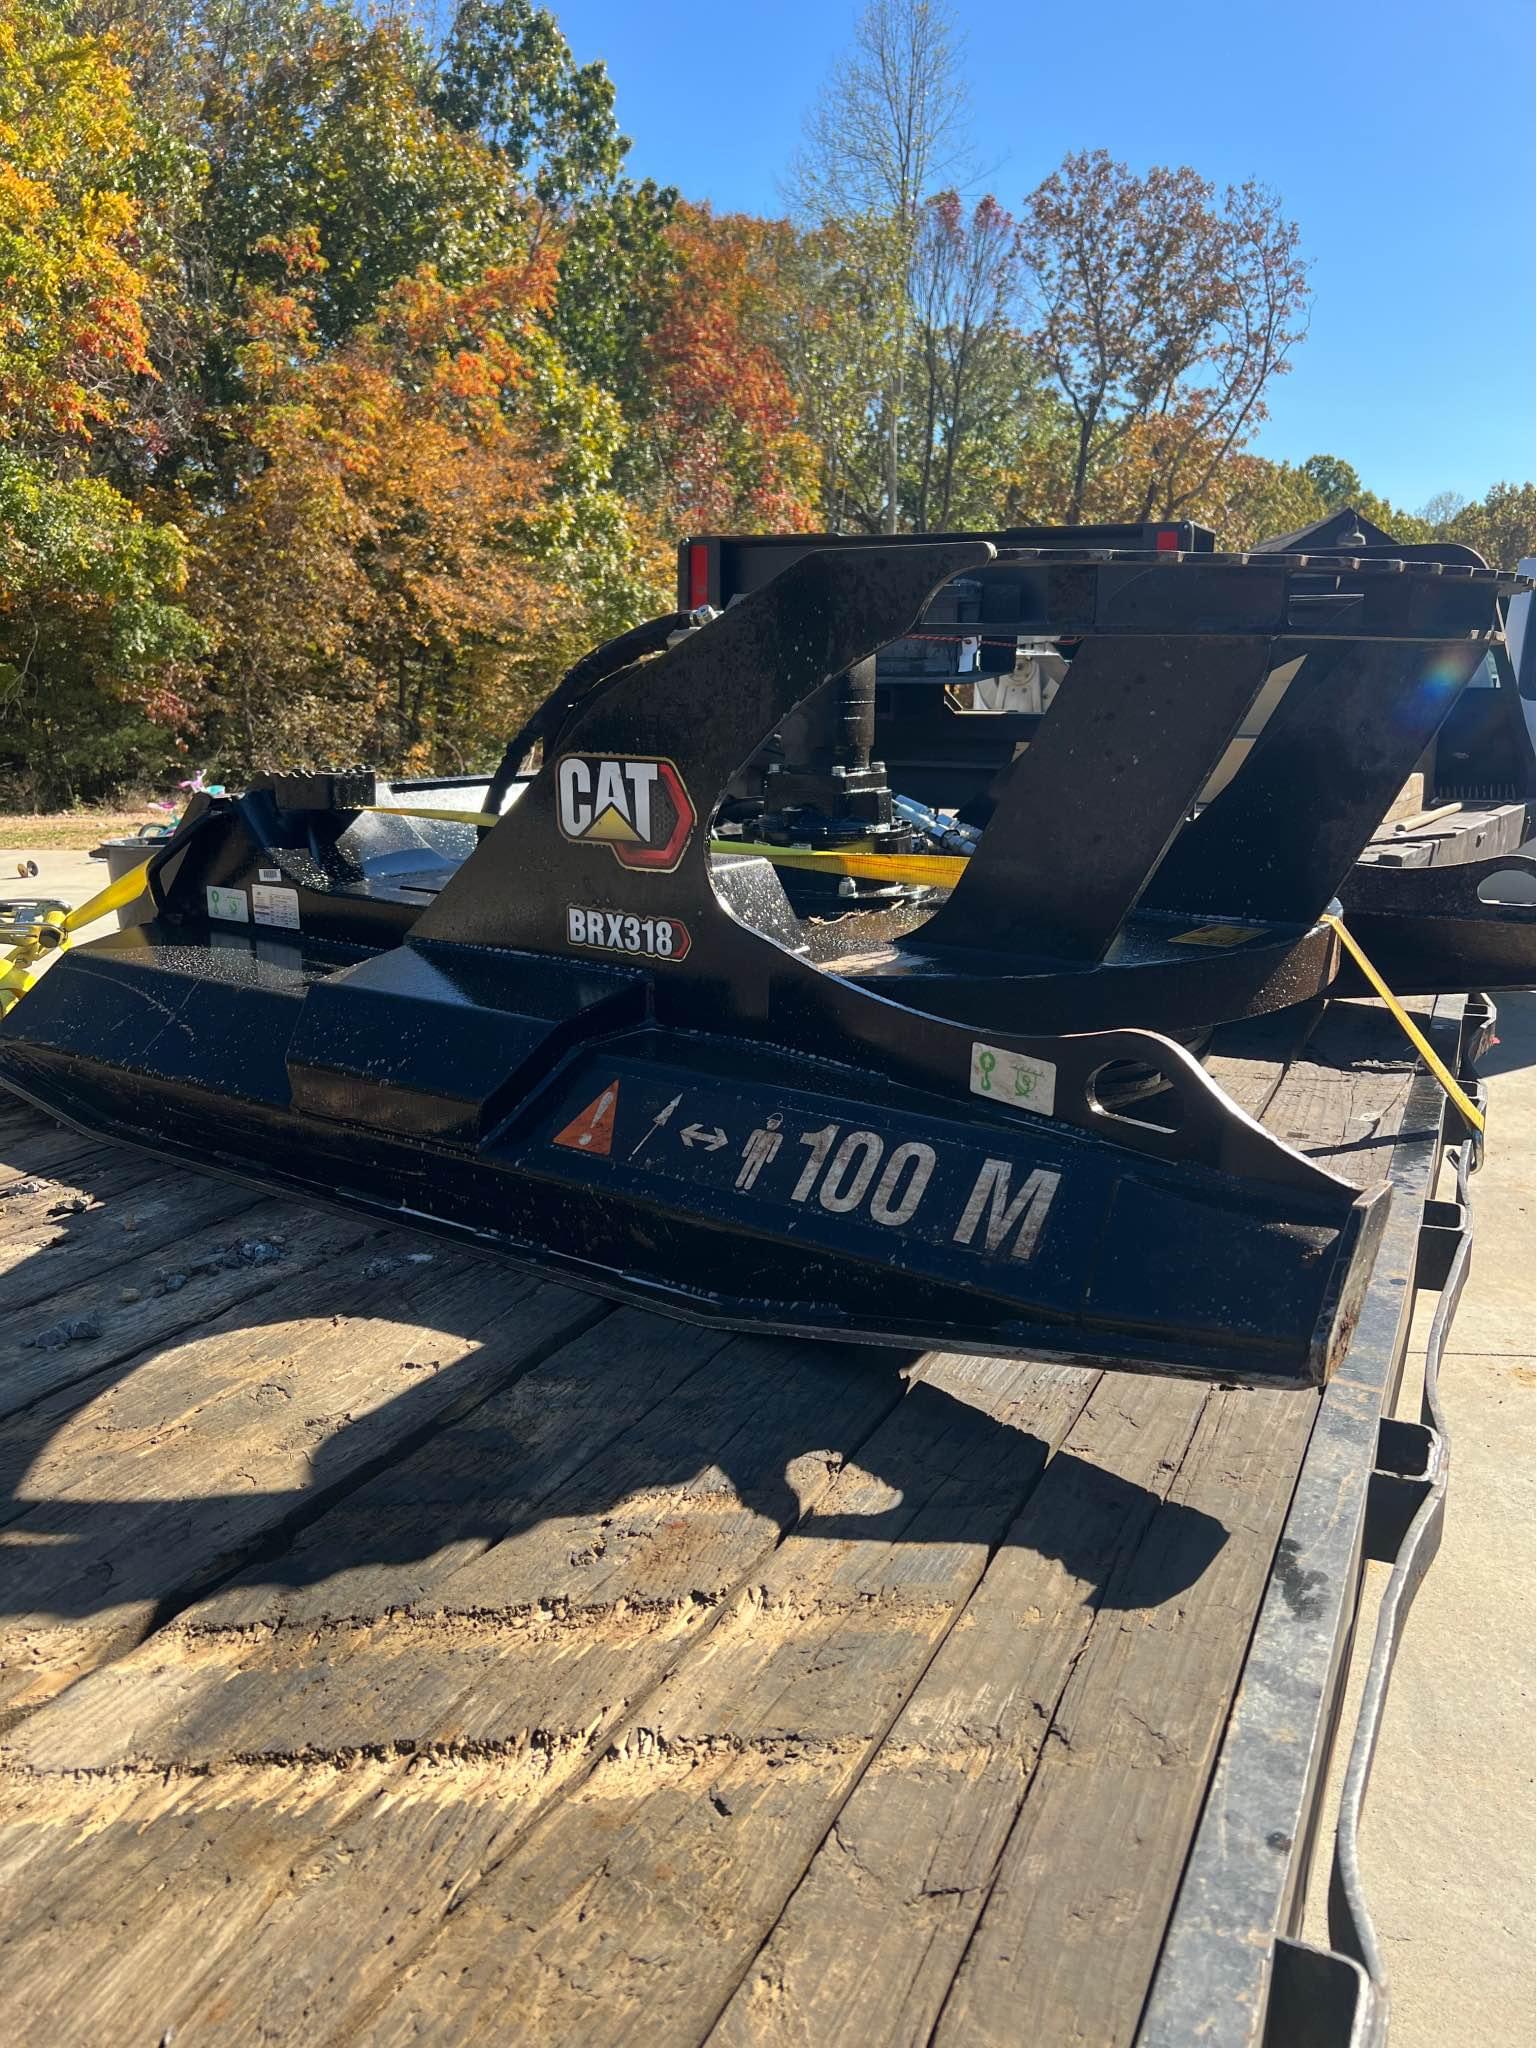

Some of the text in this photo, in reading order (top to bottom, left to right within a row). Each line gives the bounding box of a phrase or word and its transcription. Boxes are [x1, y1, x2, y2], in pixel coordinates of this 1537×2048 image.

[559, 758, 658, 842] CAT
[568, 908, 673, 956] BRX318
[791, 1124, 1063, 1260] 100 M
